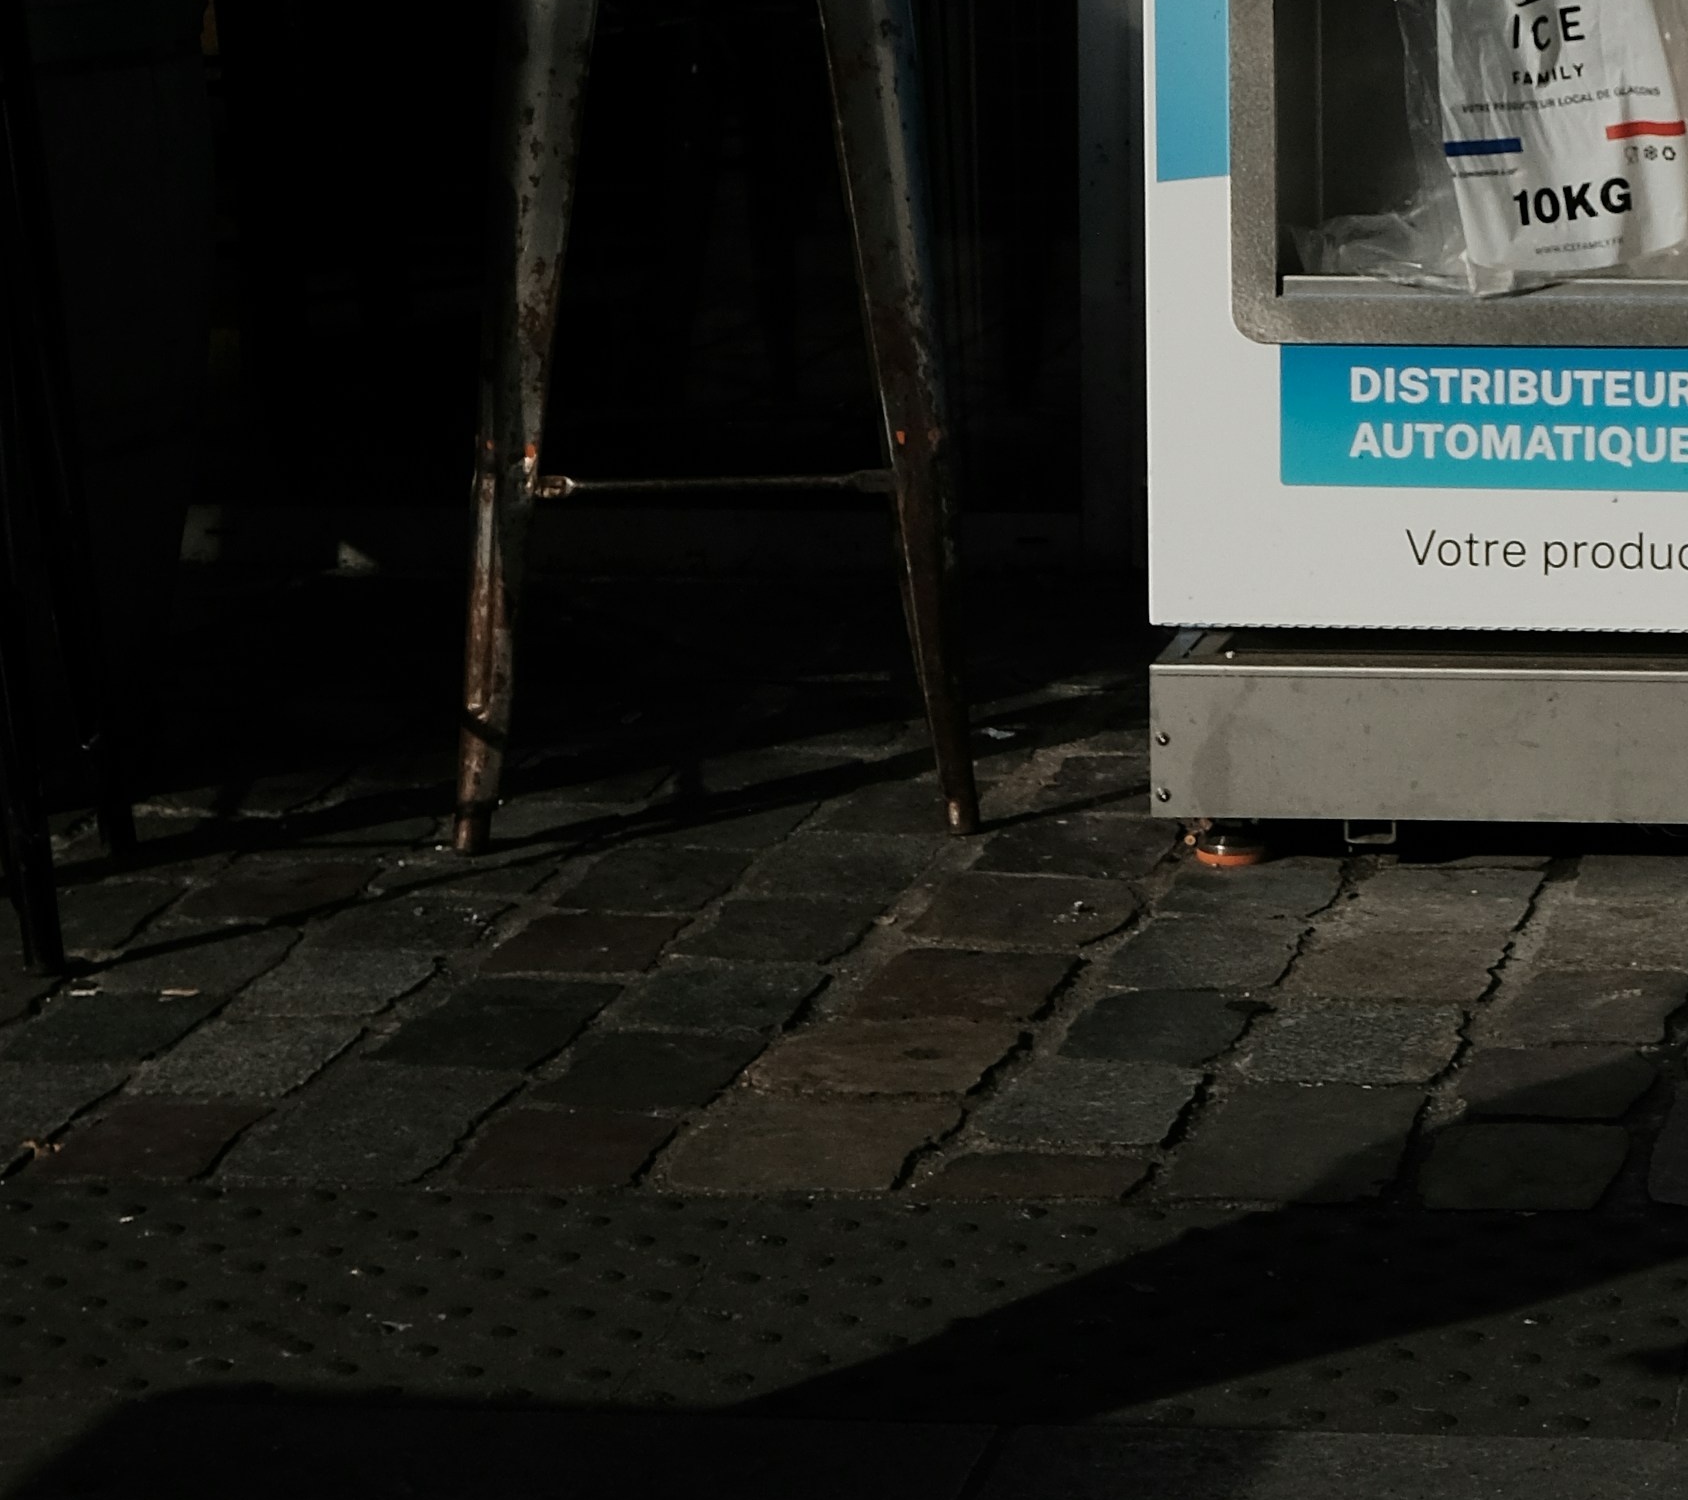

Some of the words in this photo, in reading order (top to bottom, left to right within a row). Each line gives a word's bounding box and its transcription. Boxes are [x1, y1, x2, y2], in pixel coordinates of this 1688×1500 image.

[1511, 6, 1585, 52] ICE
[1511, 64, 1584, 86] FAMILY
[1512, 177, 1632, 226] 10KG
[1406, 529, 1526, 568] Votre
